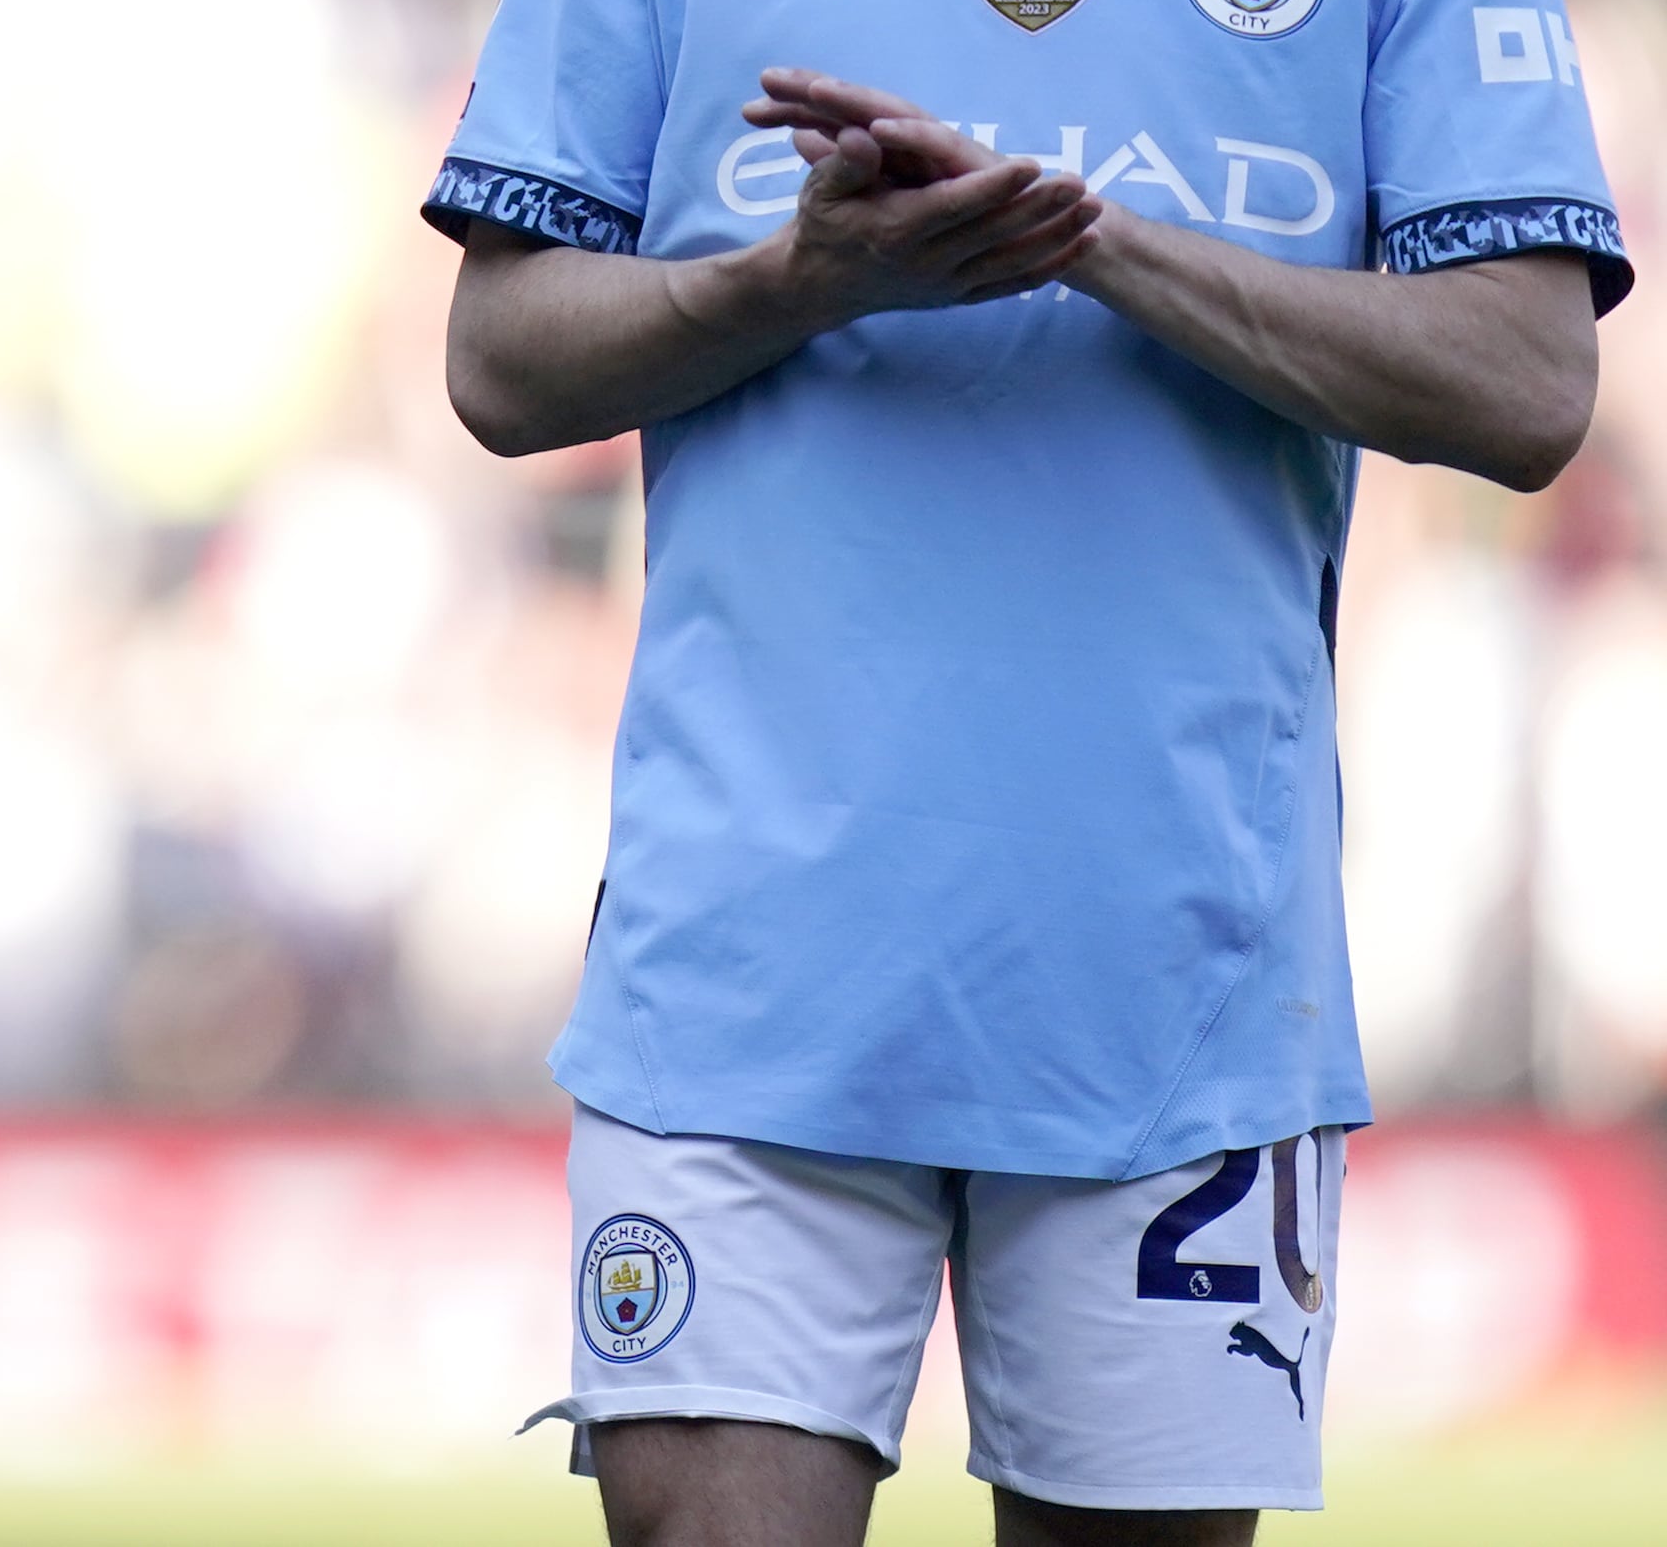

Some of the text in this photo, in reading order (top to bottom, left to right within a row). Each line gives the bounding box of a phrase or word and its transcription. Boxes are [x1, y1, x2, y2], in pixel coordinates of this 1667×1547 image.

[1019, 4, 1050, 14] 2023
[1229, 13, 1270, 30] CITY
[716, 120, 1335, 237] EHAD
[1137, 1126, 1323, 1314] 20
[588, 1226, 678, 1275] MANCHESTER
[612, 1337, 647, 1353] CITY
